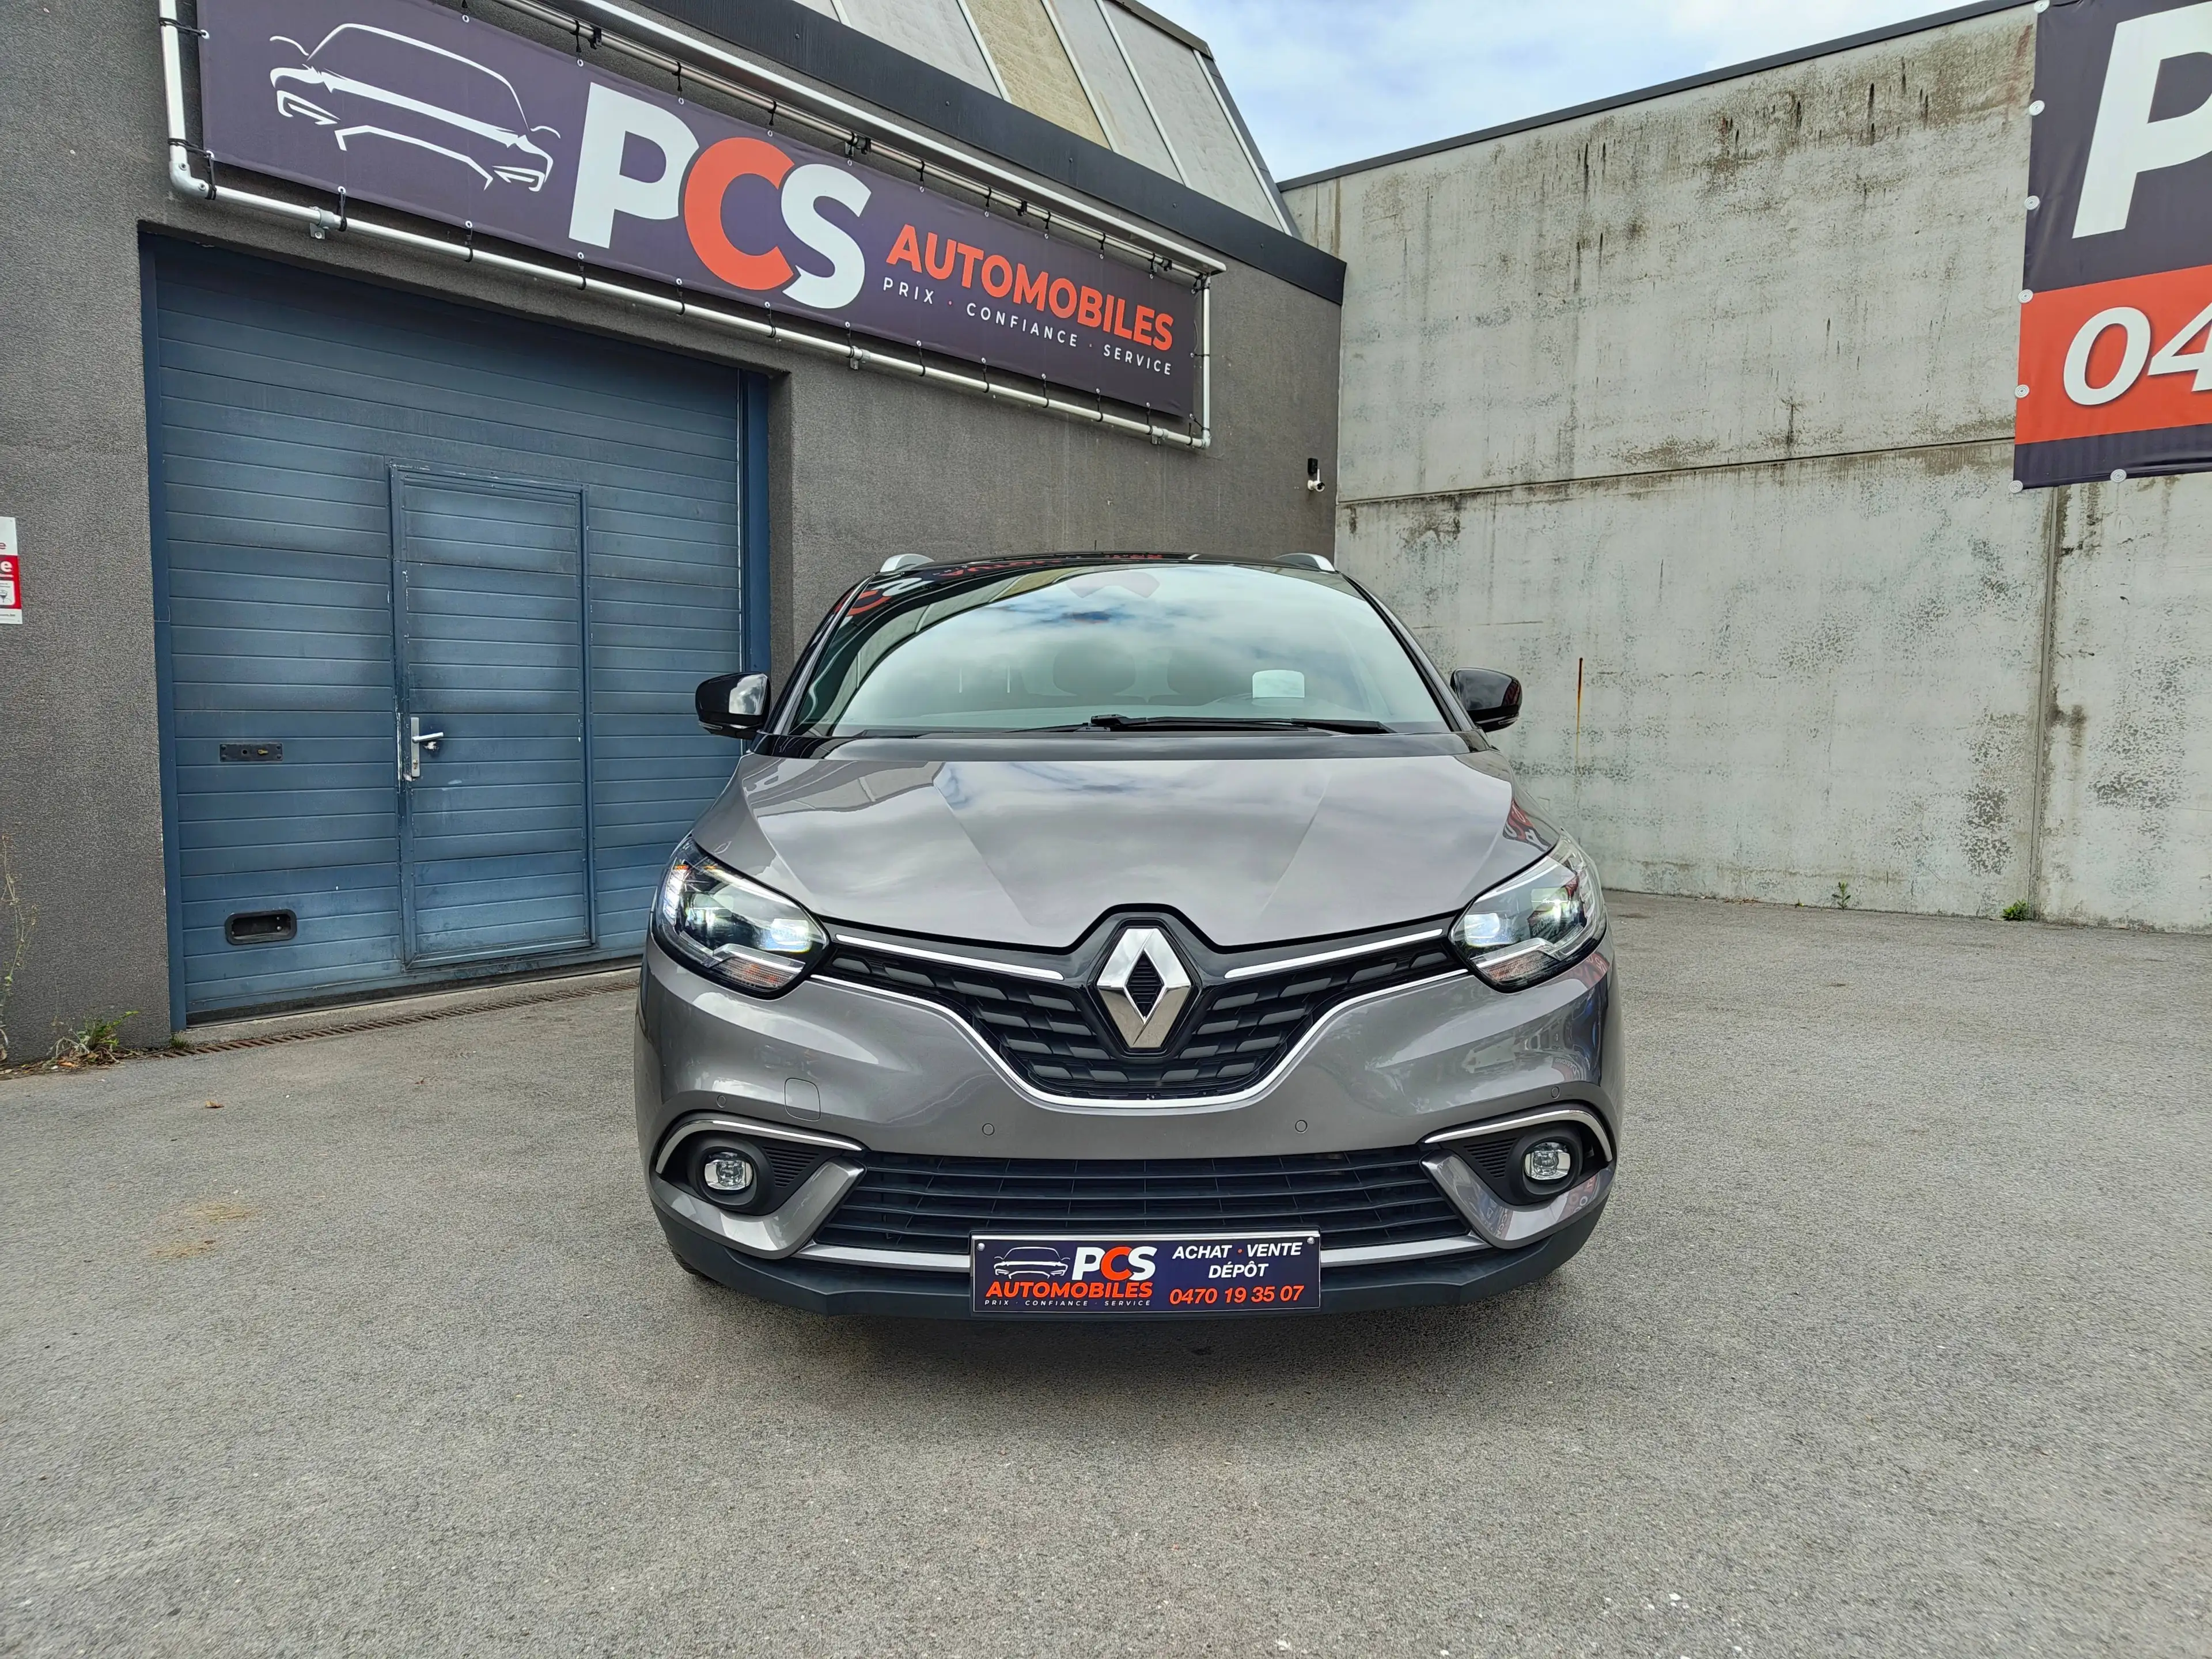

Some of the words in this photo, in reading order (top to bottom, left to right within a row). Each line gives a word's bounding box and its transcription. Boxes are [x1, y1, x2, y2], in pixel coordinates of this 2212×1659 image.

[569, 82, 872, 309] PCS
[885, 224, 1174, 351] AUTOMOBILES
[883, 276, 934, 305] PRIX
[967, 302, 1078, 347] CONFIANCE
[1103, 344, 1172, 376] SERVICE
[1071, 1245, 1157, 1281] PCS
[1172, 1245, 1232, 1259] ACHAT
[1247, 1242, 1302, 1257] VENTE
[1208, 1261, 1268, 1278] DÉPÔT
[986, 1281, 1153, 1298] AUTOMOBILES
[1169, 1288, 1218, 1305] 0470
[1224, 1287, 1247, 1303] 19
[1251, 1286, 1275, 1302] 35
[1280, 1285, 1304, 1301] 07
